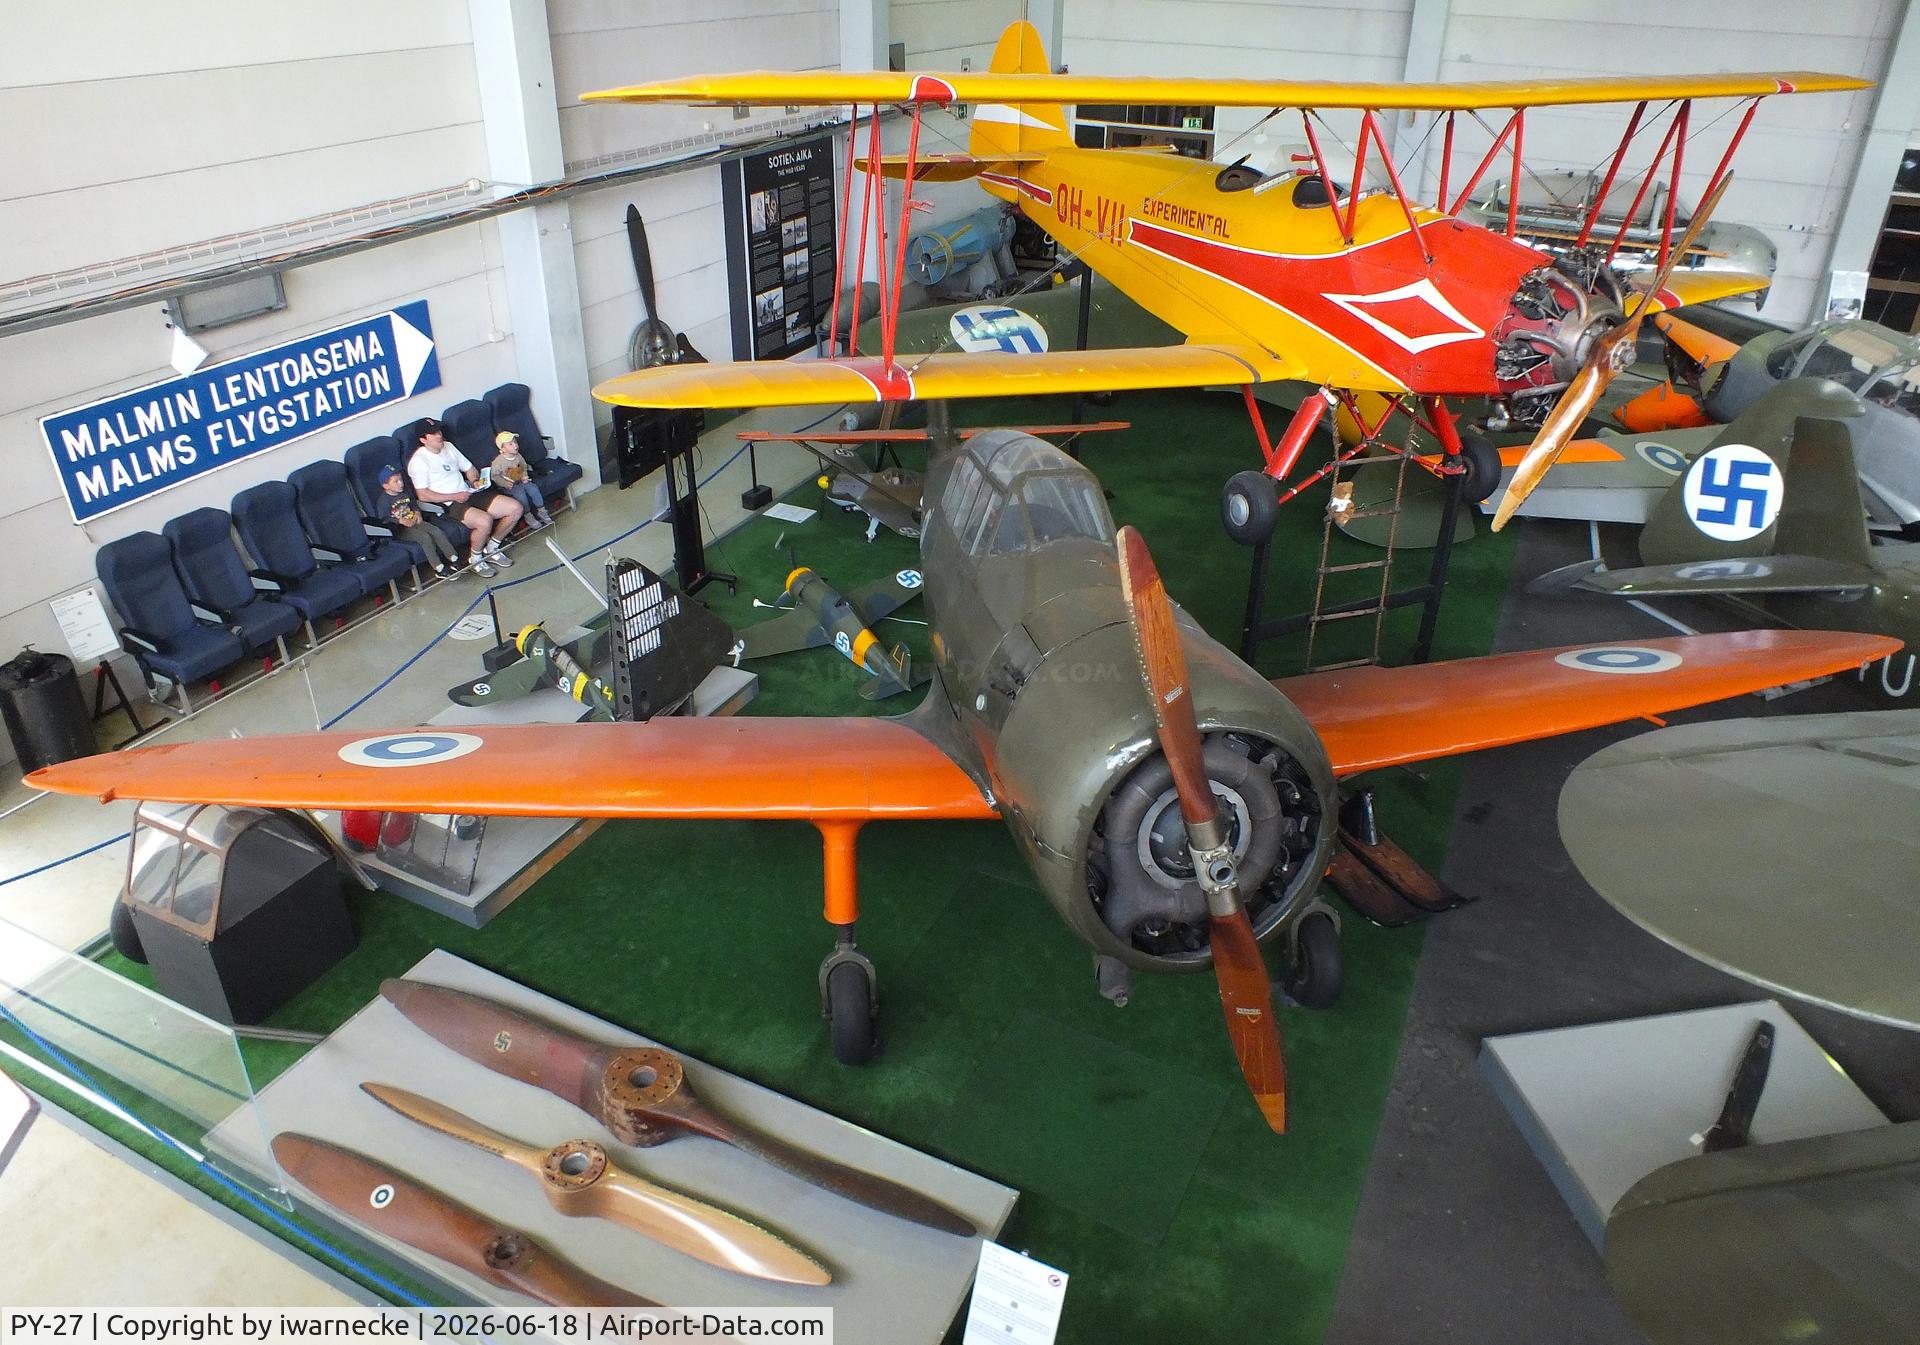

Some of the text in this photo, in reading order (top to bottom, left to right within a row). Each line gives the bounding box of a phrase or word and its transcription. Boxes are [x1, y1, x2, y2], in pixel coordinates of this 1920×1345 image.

[768, 148, 813, 169] SOTIEN AIKA
[1143, 197, 1230, 239] EXPERIMENTAL
[61, 330, 386, 463] MALMIN LENTOASEMA
[74, 364, 393, 504] MALMS FLYGSTATION
